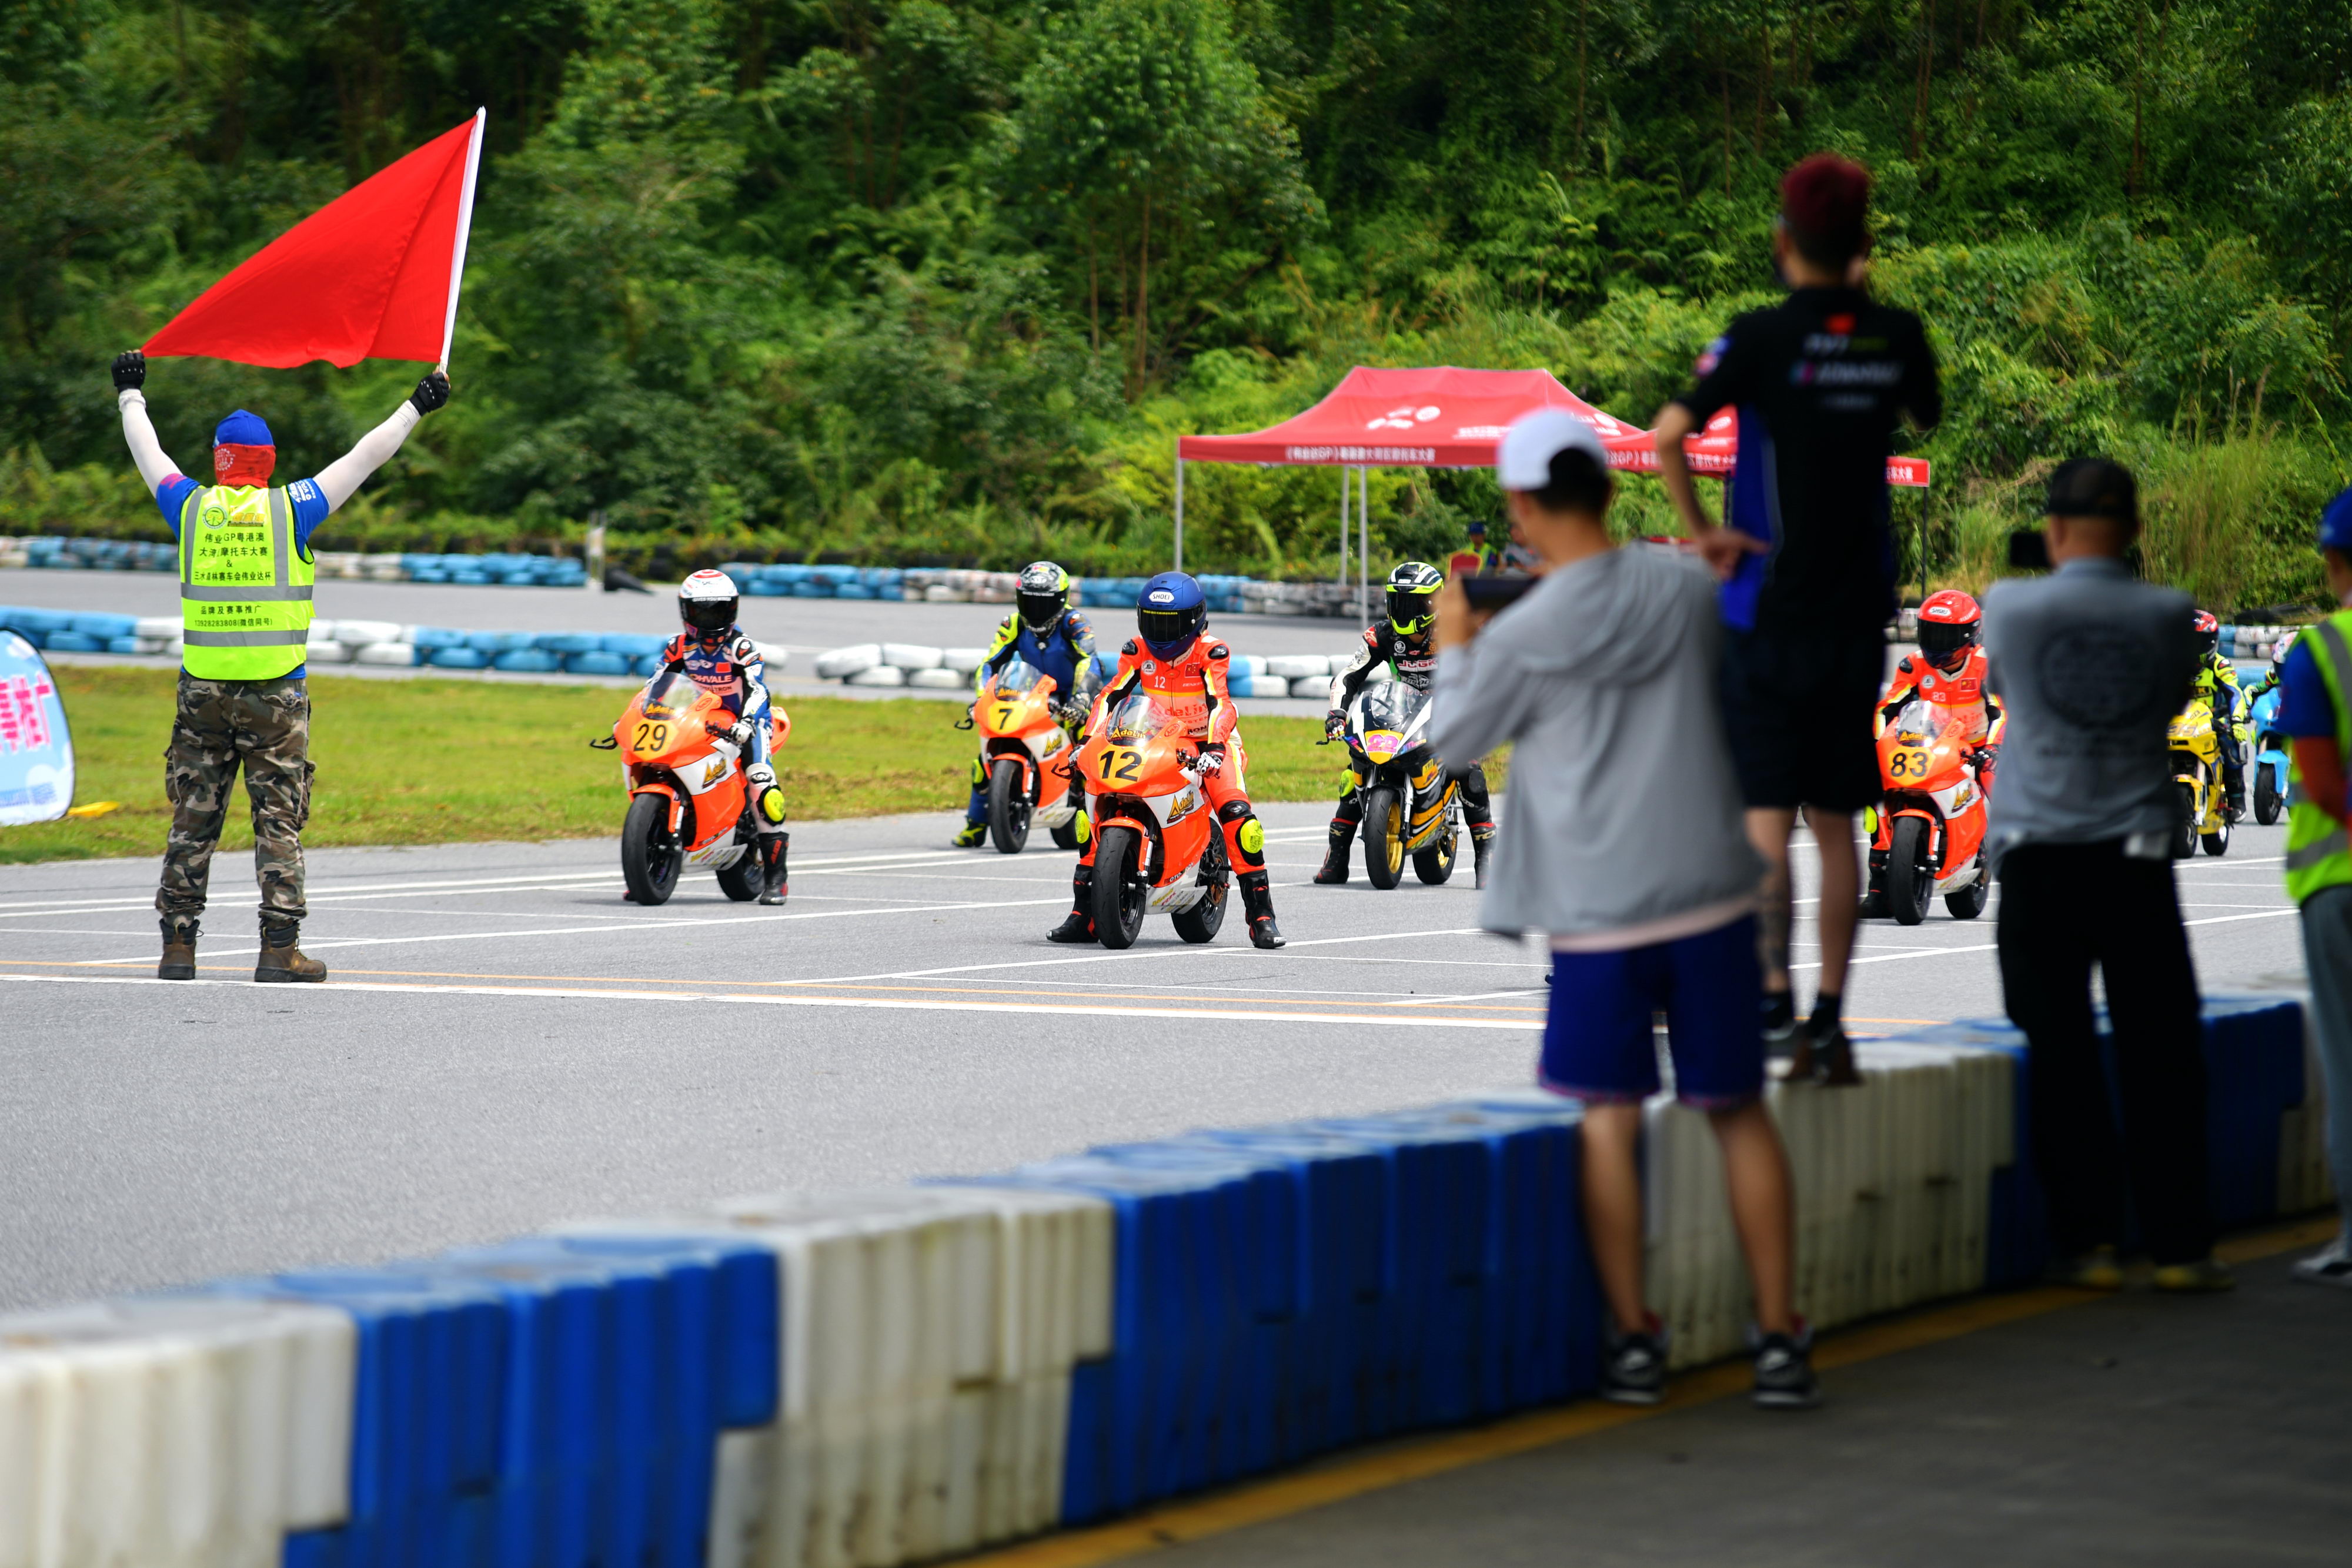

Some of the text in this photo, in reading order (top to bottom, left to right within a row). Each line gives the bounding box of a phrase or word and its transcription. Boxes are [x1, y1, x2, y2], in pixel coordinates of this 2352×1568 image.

[201, 605, 261, 614] 品牌及赛事推广
[1154, 676, 1165, 688] 12
[1932, 691, 1946, 701] 83
[998, 708, 1014, 730] 7
[633, 723, 667, 752] 29
[1366, 734, 1399, 753] 22
[1100, 750, 1142, 782] 12
[1891, 752, 1928, 777] 83
